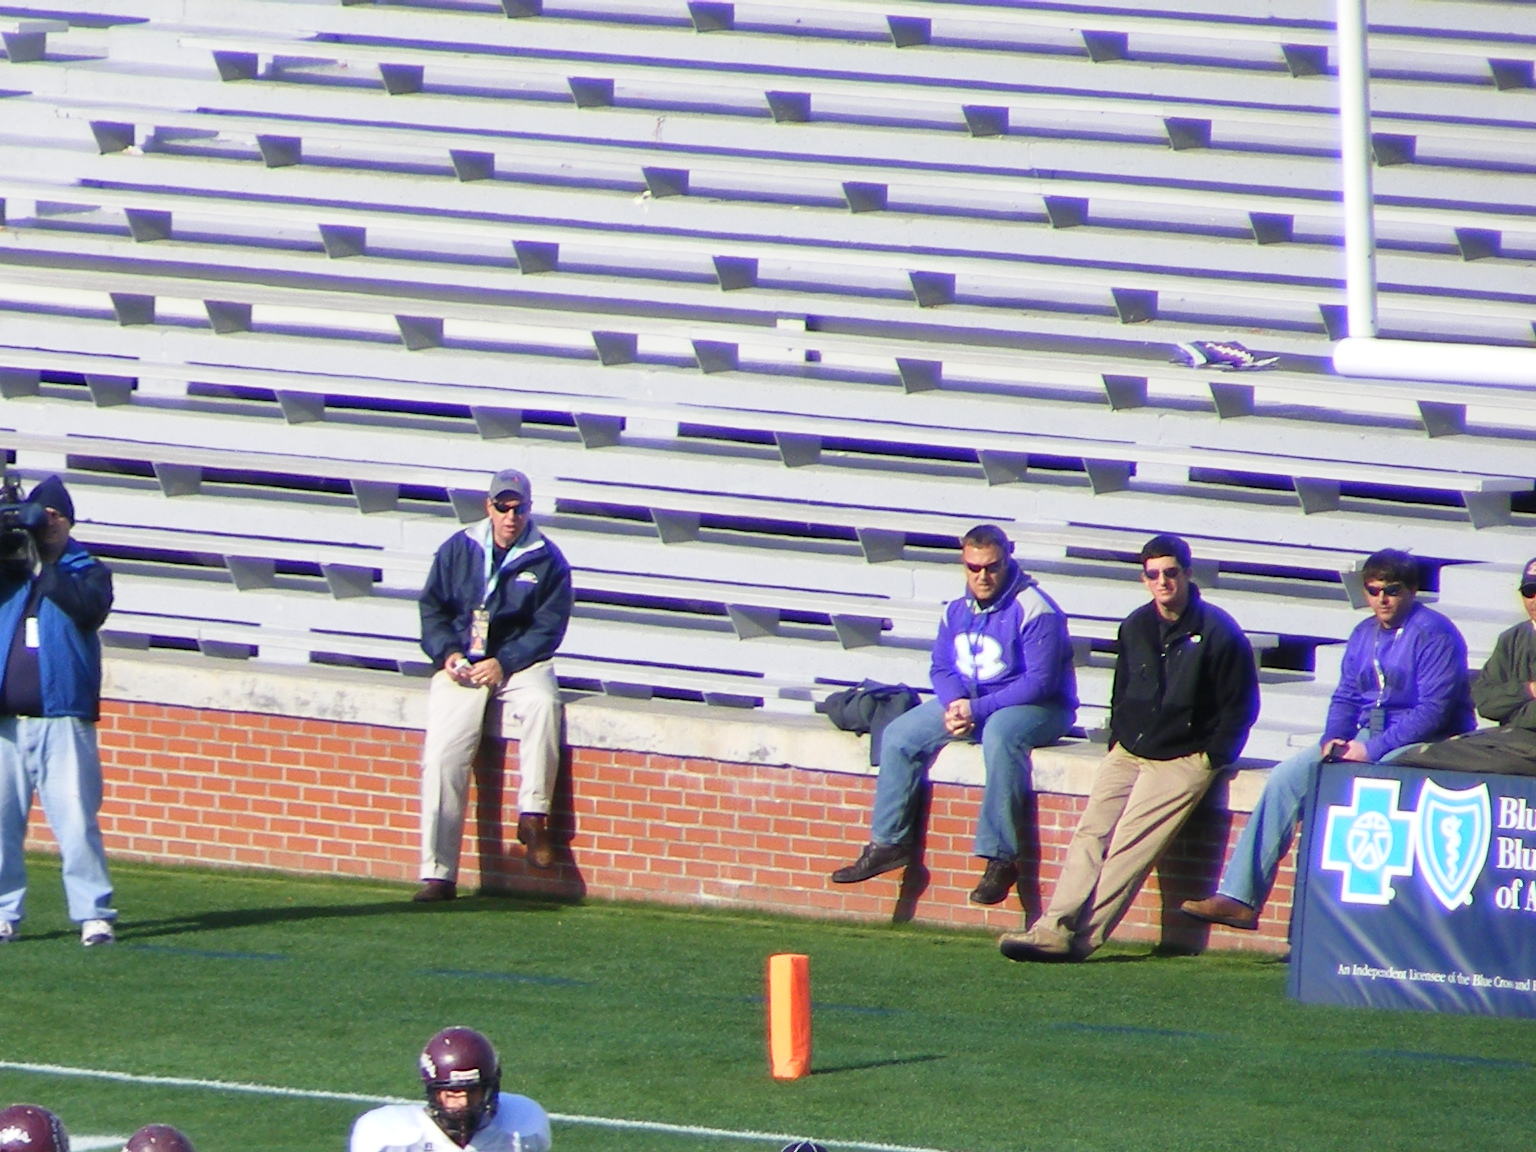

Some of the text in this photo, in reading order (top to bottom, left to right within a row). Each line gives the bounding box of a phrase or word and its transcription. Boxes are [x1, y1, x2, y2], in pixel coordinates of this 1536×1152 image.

[1495, 878, 1524, 910] of
[1337, 963, 1351, 976] An
[1352, 963, 1407, 981] Independent
[1409, 968, 1447, 983] Licensee
[1472, 973, 1493, 988] Blue
